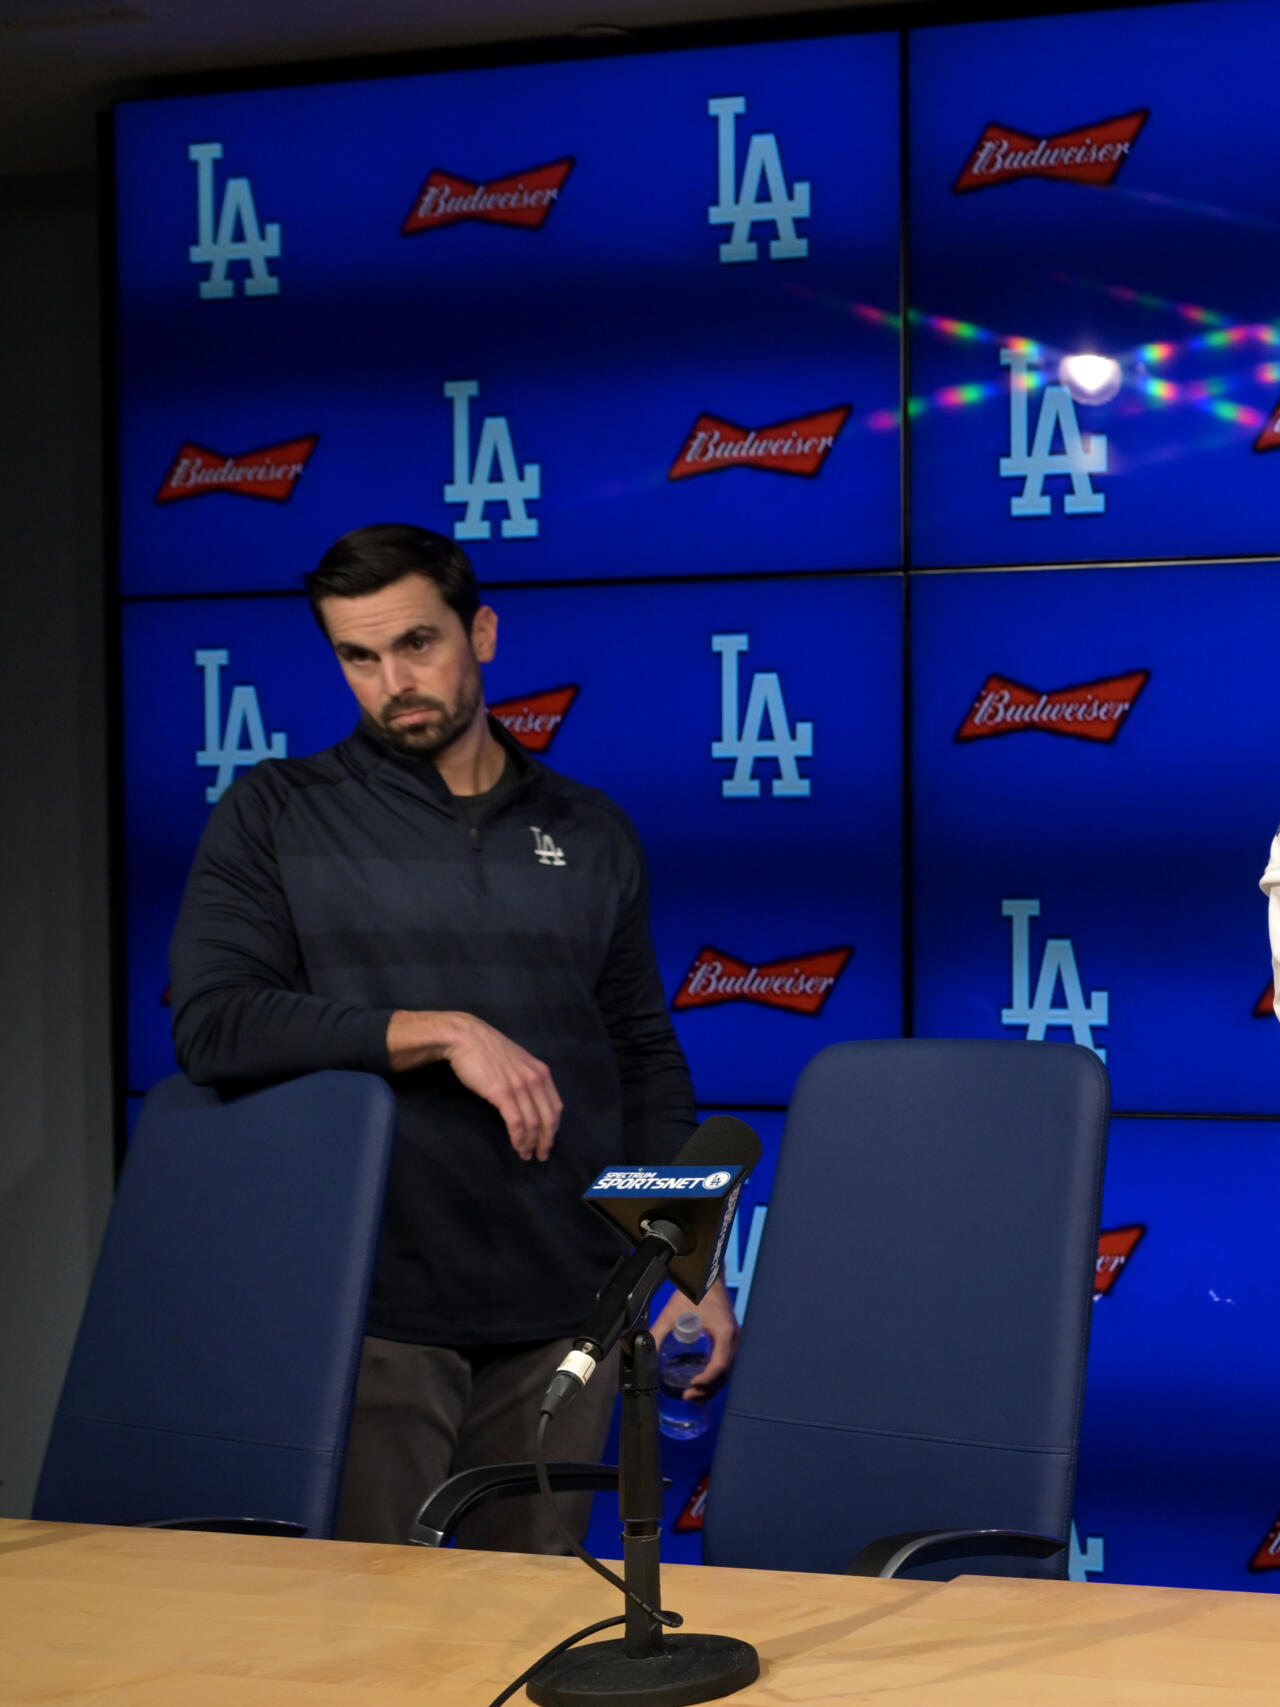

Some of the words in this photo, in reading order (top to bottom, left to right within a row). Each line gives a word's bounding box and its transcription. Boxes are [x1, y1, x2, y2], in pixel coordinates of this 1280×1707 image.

[972, 138, 1130, 174] Budweiser
[708, 96, 811, 262] LA
[189, 143, 281, 298] LA
[417, 185, 559, 218] Budweiser
[685, 430, 834, 463] Budweiser
[1000, 346, 1108, 516] LA
[169, 457, 304, 488] Budweiser
[444, 381, 541, 540] LA
[195, 649, 287, 803] LA
[711, 633, 813, 798] LA
[973, 690, 1130, 725] Budweiser
[529, 825, 567, 867] LA
[687, 961, 834, 995] Budweiser
[1002, 899, 1109, 1065] LA
[592, 1177, 704, 1190] SPORTSNET
[604, 1171, 657, 1179] SPECTRUM
